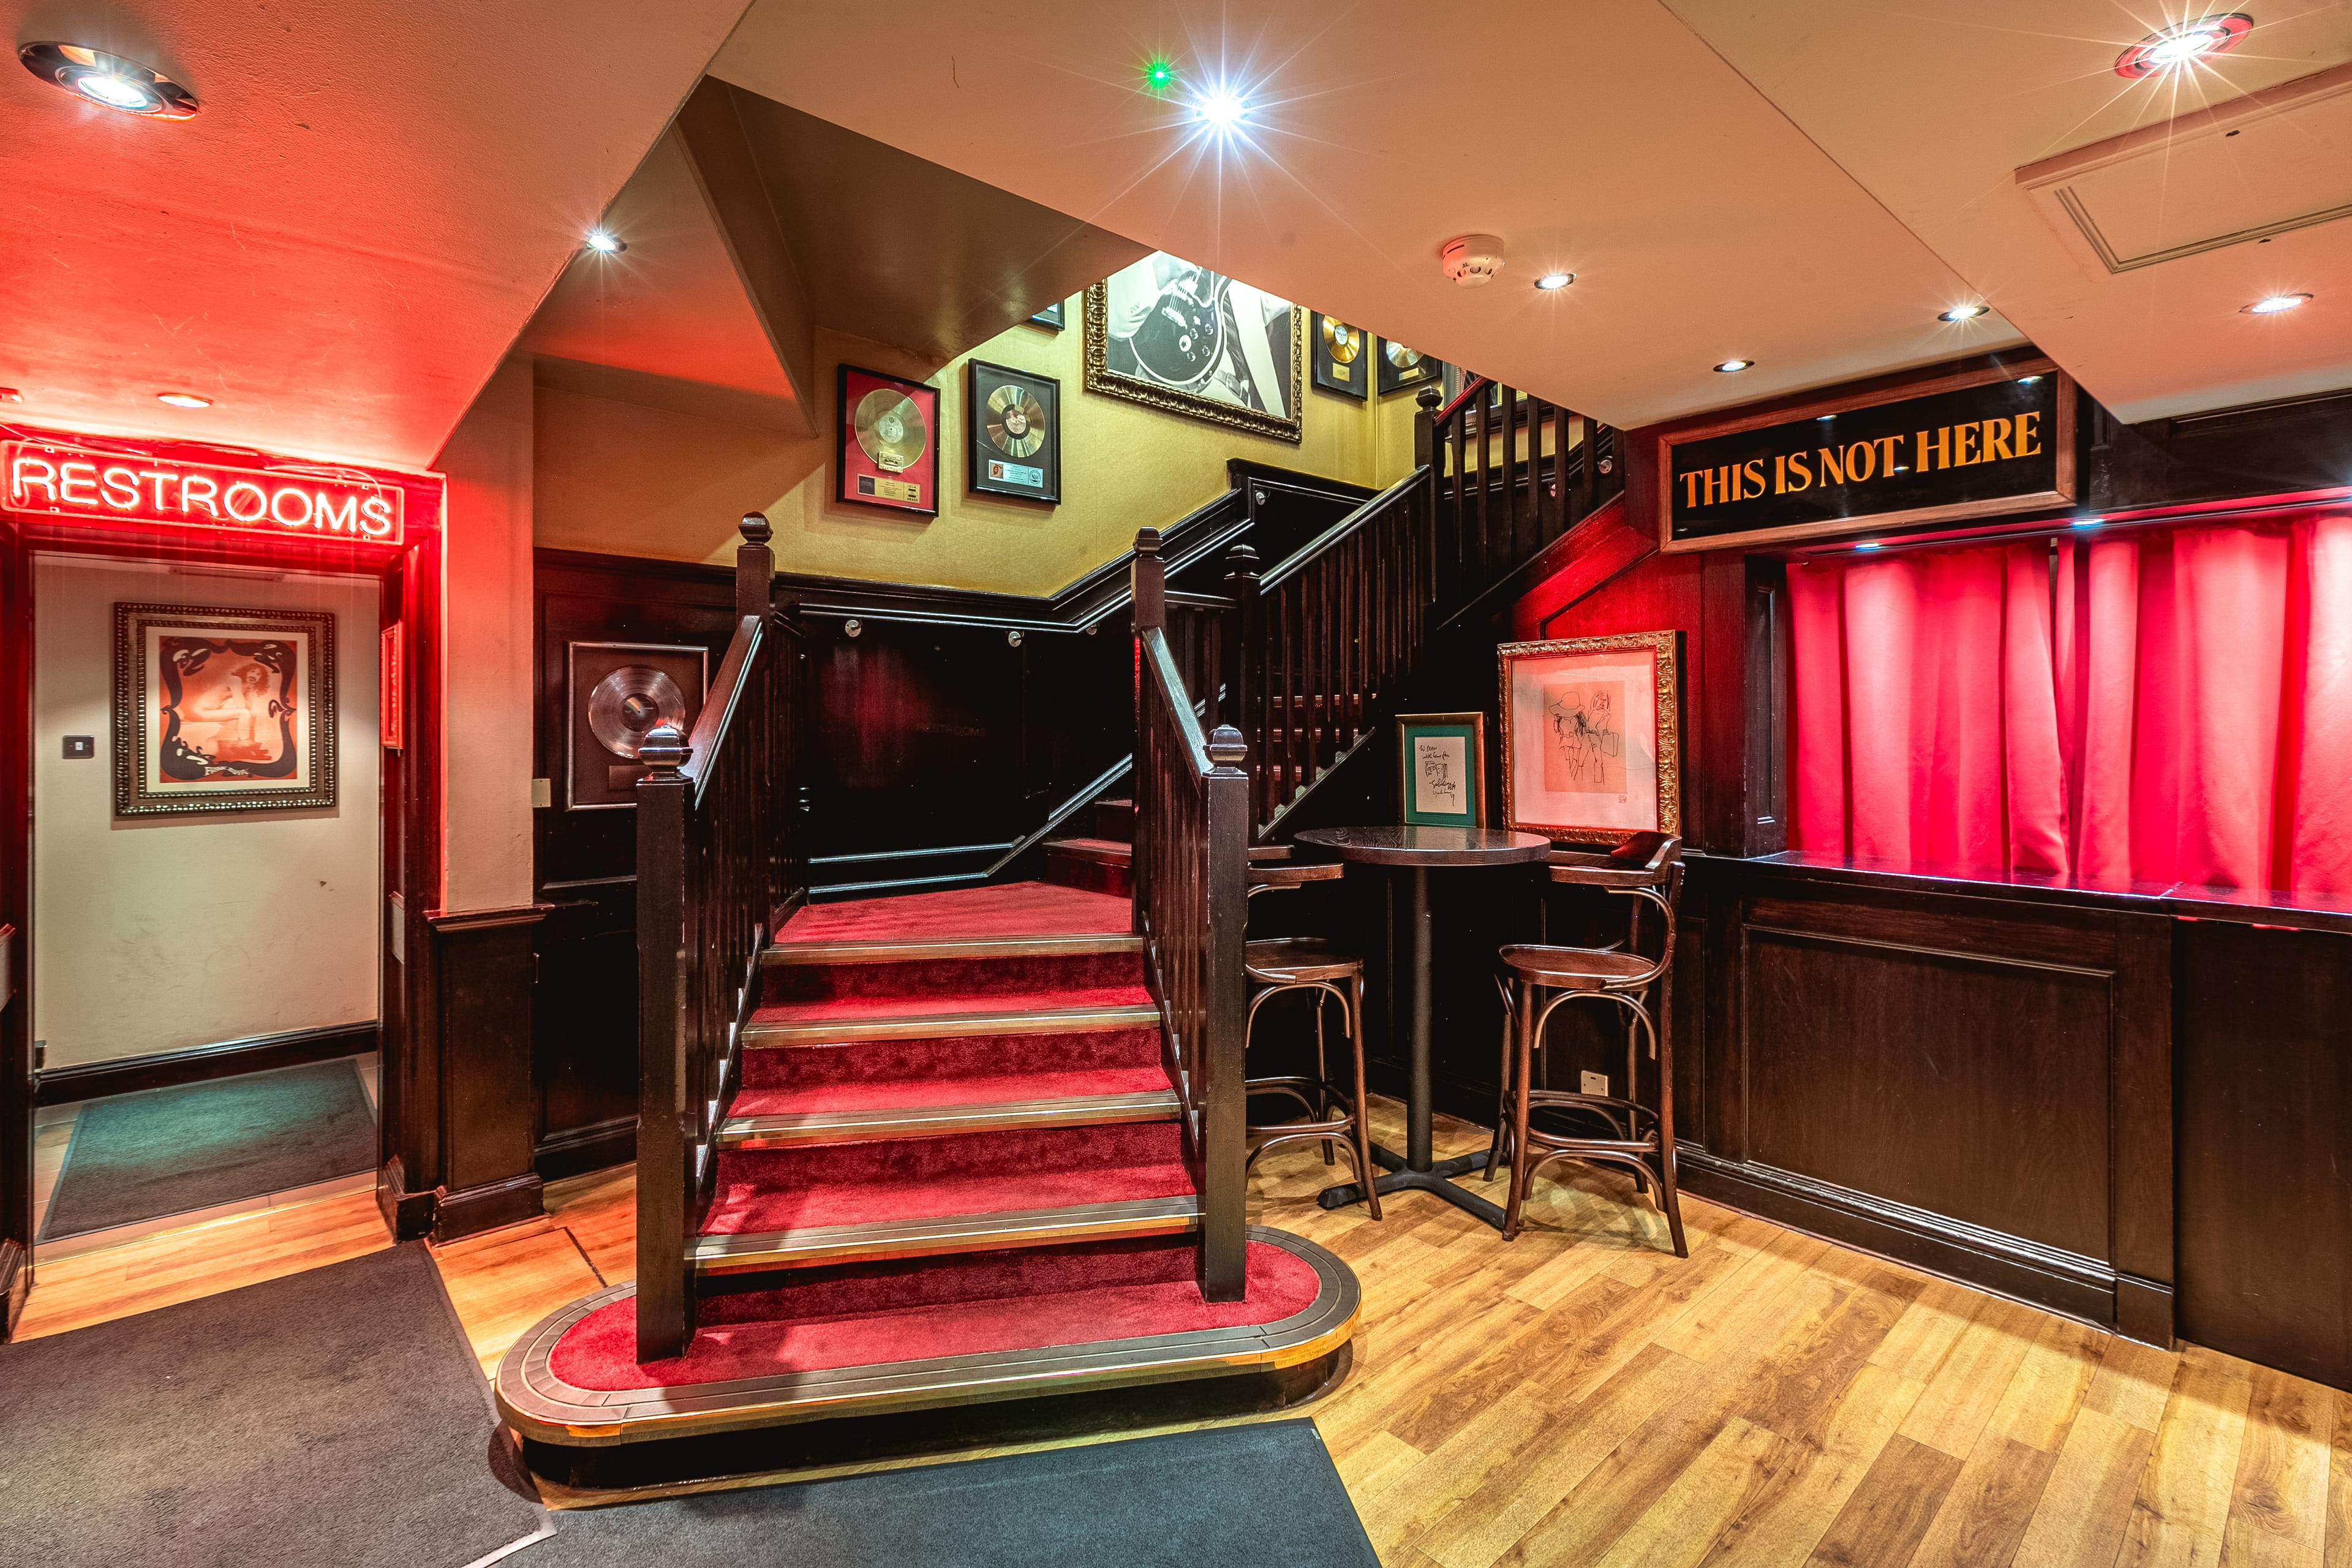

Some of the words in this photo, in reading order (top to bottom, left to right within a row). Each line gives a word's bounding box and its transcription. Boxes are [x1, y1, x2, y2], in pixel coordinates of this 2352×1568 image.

[11, 457, 392, 537] RESTROOMS
[1679, 459, 1766, 508] THIS
[1774, 450, 1812, 496] IS
[1817, 434, 1904, 488] NOT
[1915, 411, 2042, 473] HERE
